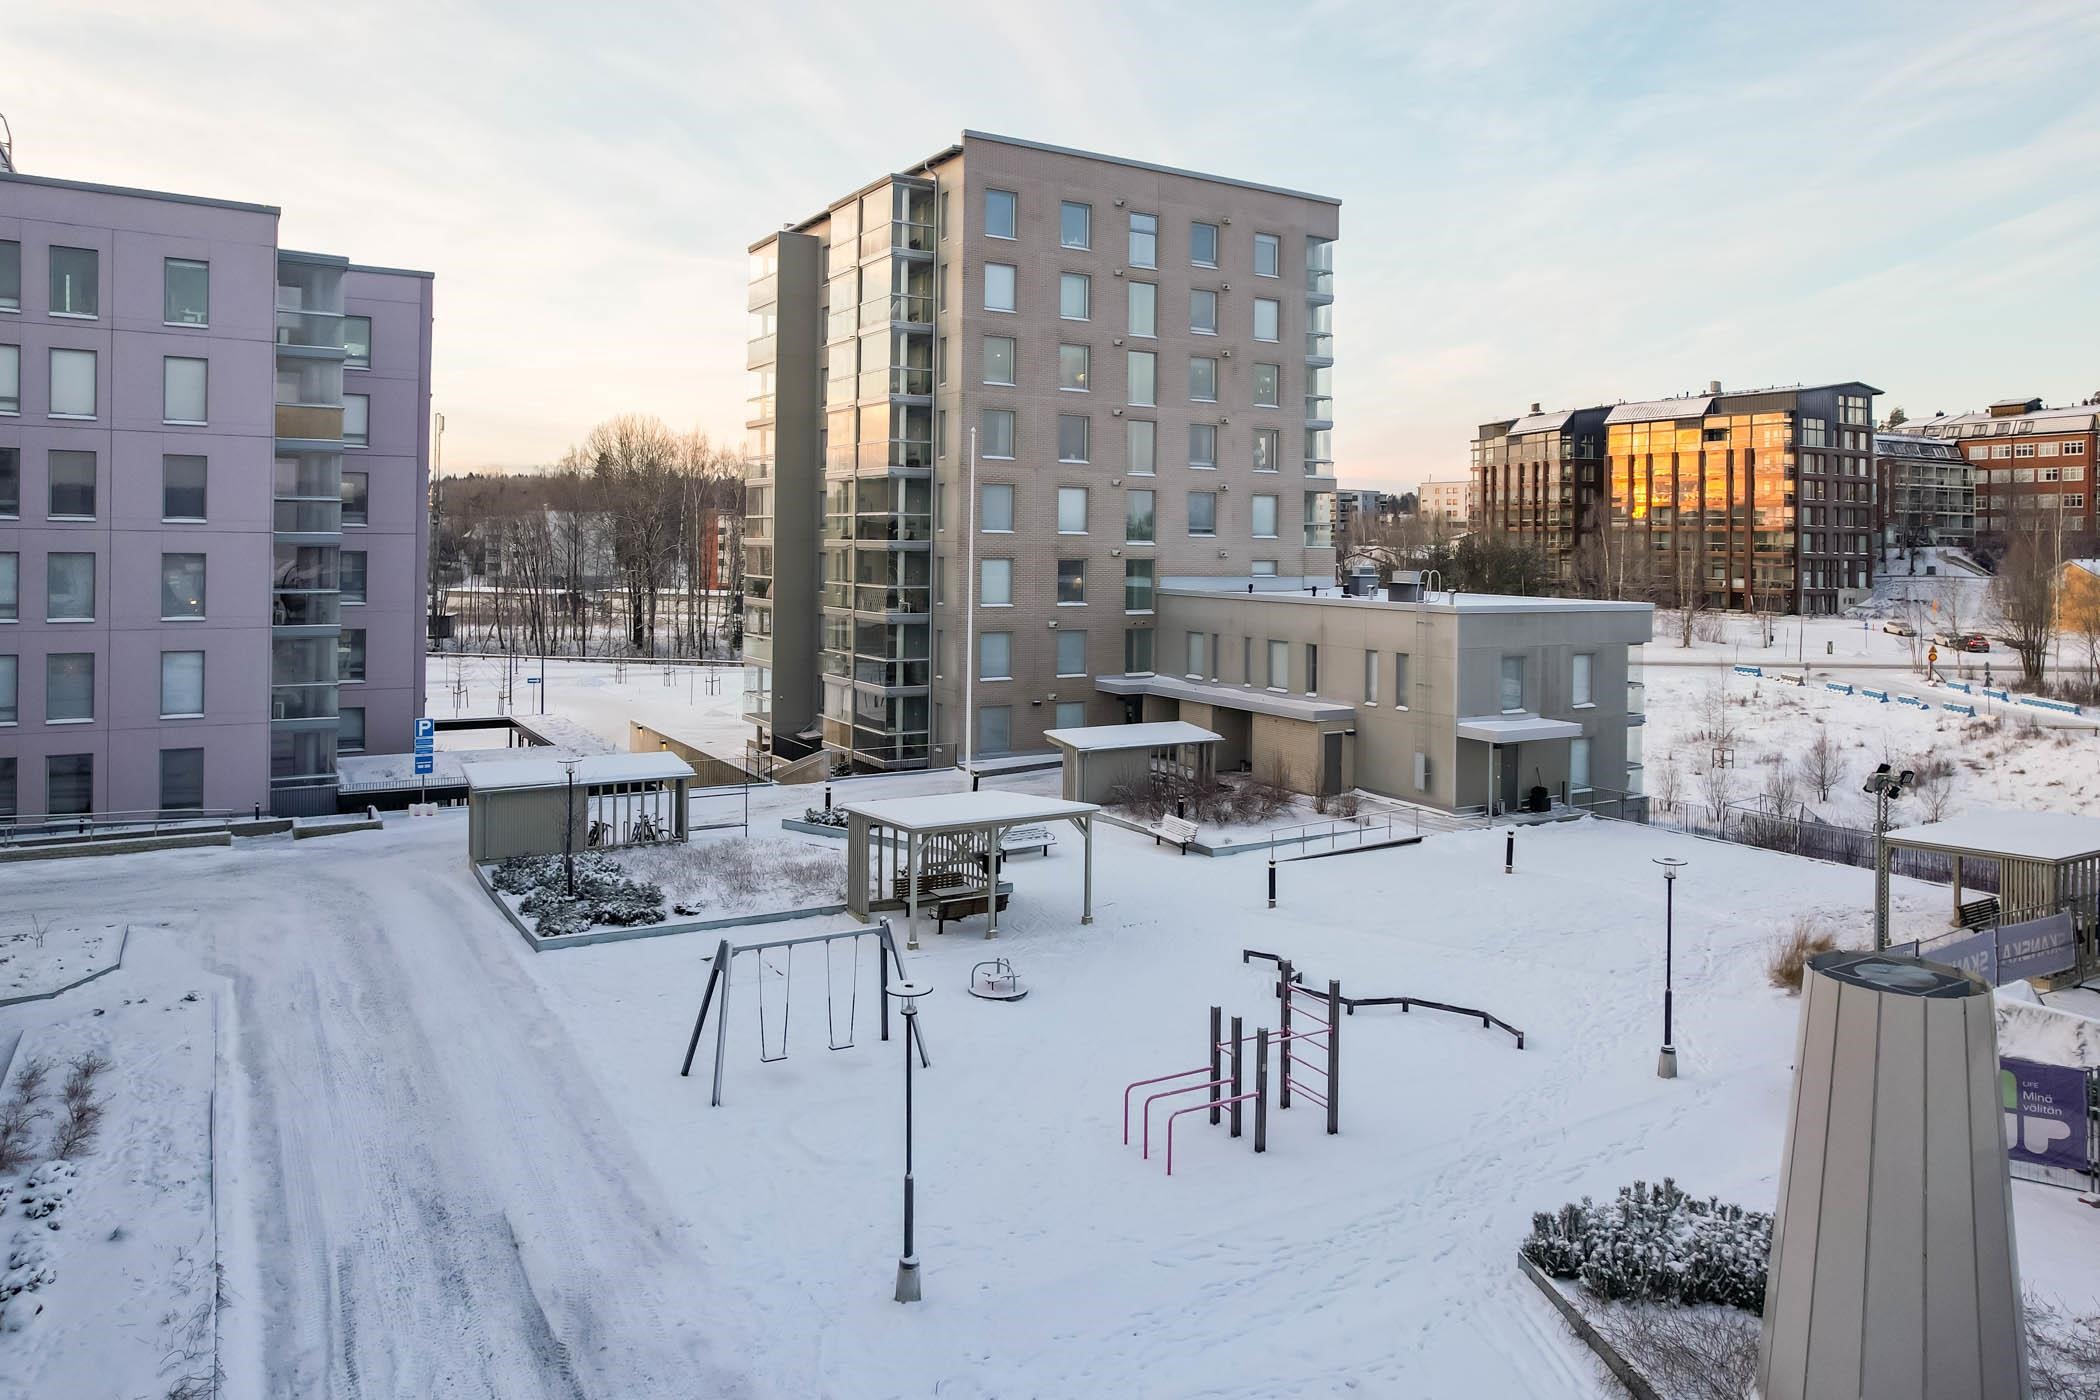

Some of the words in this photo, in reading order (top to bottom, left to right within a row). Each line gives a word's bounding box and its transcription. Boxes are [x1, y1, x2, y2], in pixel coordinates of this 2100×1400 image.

[418, 720, 432, 737] P
[2023, 1090, 2053, 1104] Minä
[2023, 1103, 2063, 1116] välitän
